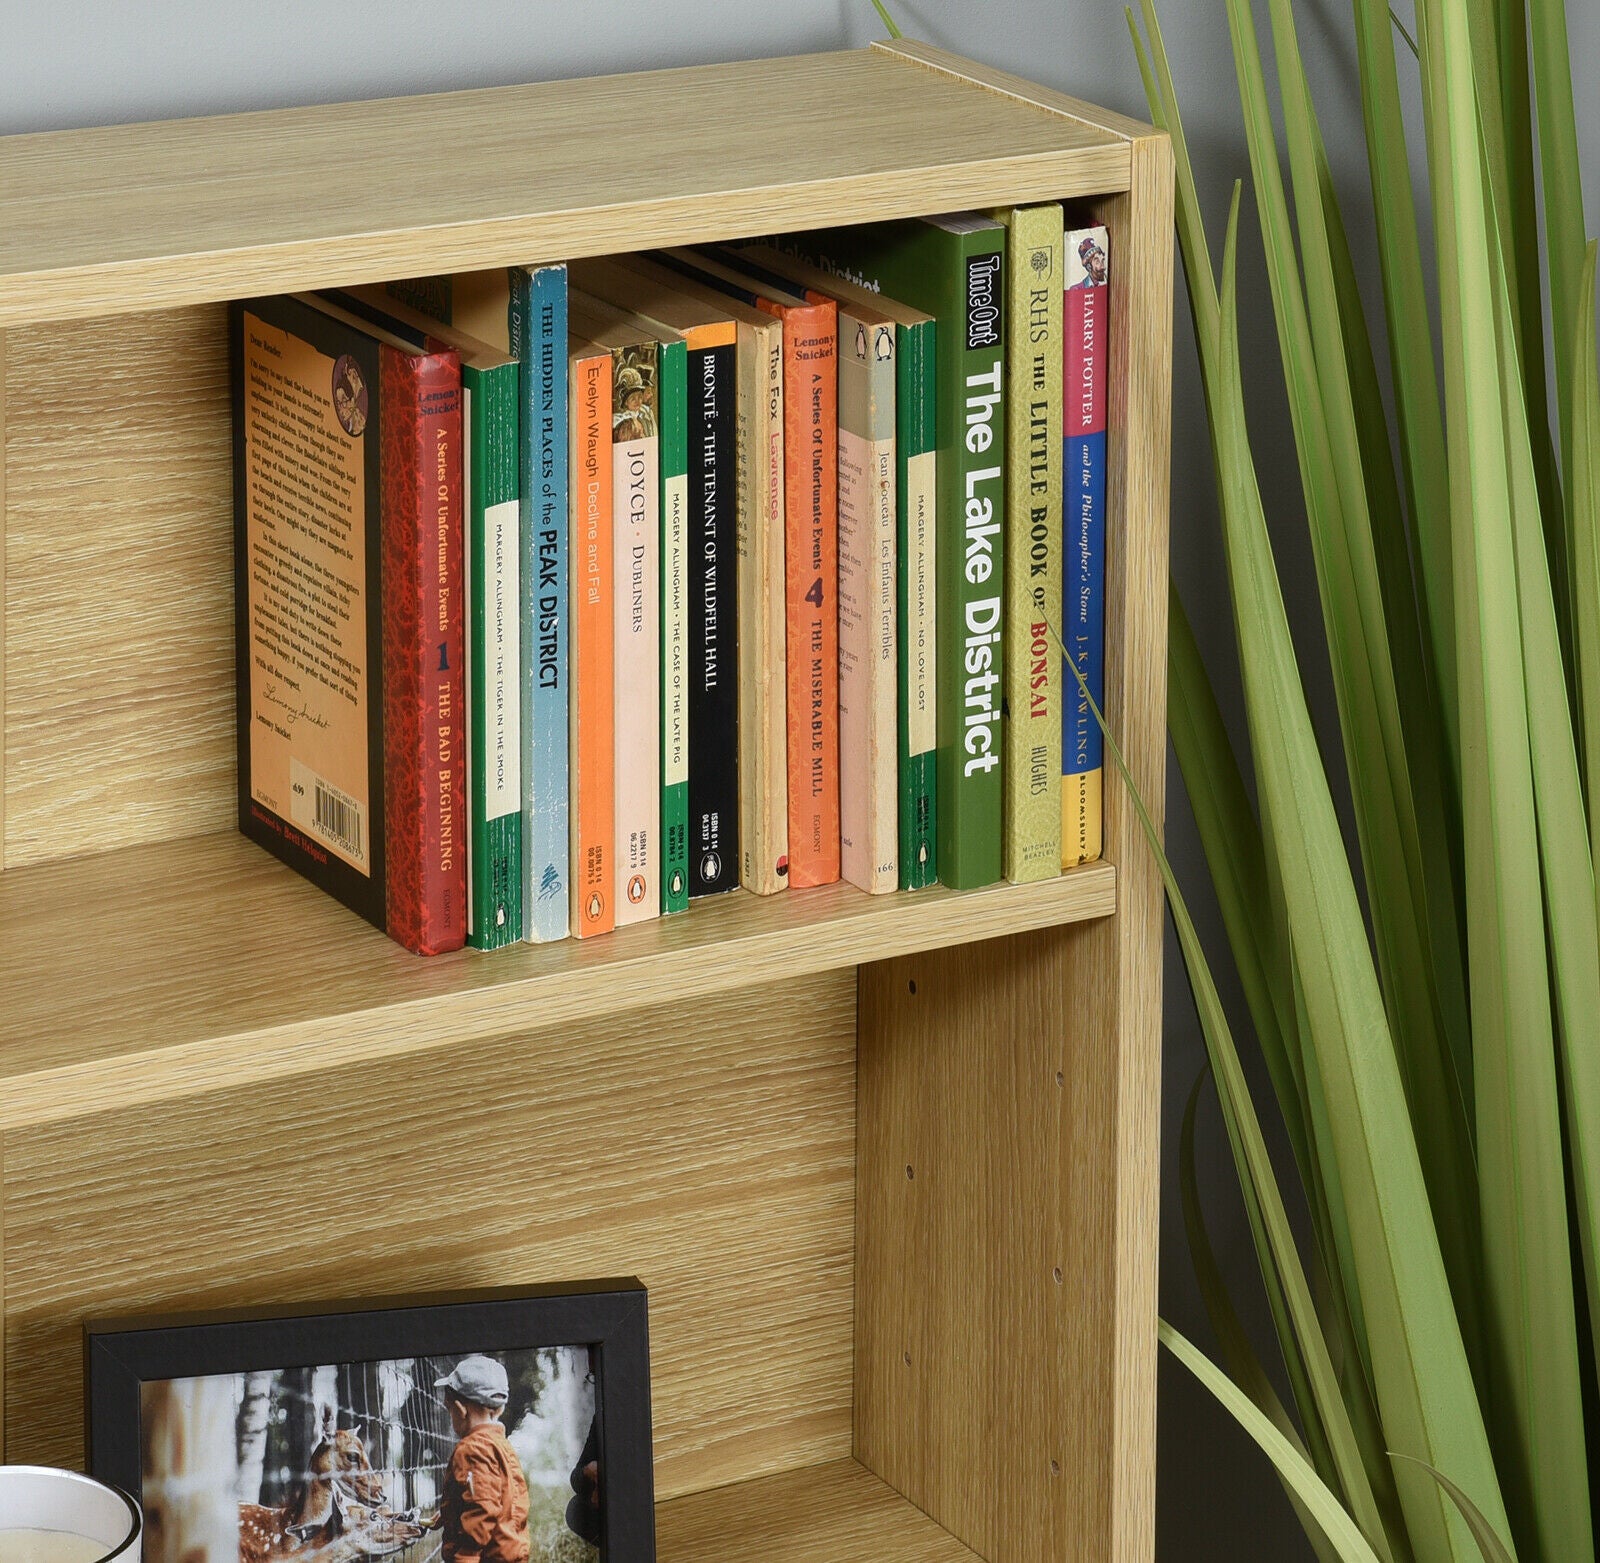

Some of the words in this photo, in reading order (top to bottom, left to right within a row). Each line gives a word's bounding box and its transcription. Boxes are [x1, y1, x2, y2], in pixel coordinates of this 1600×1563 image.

[542, 302, 553, 338] THE
[1030, 288, 1048, 343] RHS
[1082, 292, 1094, 352] HARRY
[512, 312, 521, 359] Distric
[794, 335, 835, 348] Lemony
[796, 349, 834, 360] Snicket
[542, 344, 553, 410] HIDDEN
[770, 345, 780, 380] The
[811, 374, 822, 383] A
[1033, 353, 1045, 391] THE
[418, 390, 458, 402] Lemony
[585, 367, 599, 419] Evelyn
[704, 355, 718, 420] BRONTË
[770, 387, 780, 420] Fox
[812, 387, 822, 425] Series
[1082, 357, 1093, 426] POTTER
[420, 402, 458, 415] Snicket
[965, 362, 1001, 453] The
[437, 428, 447, 439] A
[542, 417, 553, 479] PLACES
[585, 422, 599, 477] Waugh
[704, 432, 716, 467] THE
[812, 429, 823, 446] Of
[1030, 401, 1048, 496] LITTLE
[437, 443, 448, 481] Series
[879, 452, 889, 477] Jean
[1082, 445, 1092, 467] and
[437, 485, 448, 502] Of
[542, 483, 557, 498] of
[627, 450, 645, 524] JOYCE
[770, 432, 780, 520] Lawrence
[812, 449, 823, 524] Unfortunate
[1082, 469, 1092, 487] the
[542, 503, 556, 525] the
[588, 482, 600, 540] Decline
[672, 493, 680, 543] MARGERY
[704, 469, 716, 538] TENANT
[965, 466, 1001, 584] Lake
[1030, 505, 1048, 578] BOOK
[1079, 494, 1092, 582] Philosopher's
[437, 506, 449, 584] Unfortunate
[540, 530, 557, 590] PEAK
[588, 544, 600, 572] and
[705, 542, 716, 564] OF
[813, 528, 822, 570] Events
[882, 540, 891, 558] Les
[588, 578, 600, 604] Fall
[632, 544, 645, 633] DUBLINERS
[882, 561, 892, 604] Enfants
[1033, 587, 1045, 610] OF
[438, 589, 450, 632] Events
[705, 566, 716, 645] WILDFELL
[1080, 587, 1091, 623] Stone
[539, 596, 557, 689] DISTRICT
[673, 622, 681, 642] THE
[811, 620, 822, 652] THE
[882, 607, 892, 660] Terribles
[918, 630, 925, 647] NO
[673, 645, 681, 672] CASE
[705, 648, 716, 691] HALL
[1030, 622, 1048, 720] BONSAI
[438, 681, 450, 720] THE
[673, 675, 681, 690] OF
[964, 597, 1001, 777] District
[497, 714, 504, 726] IN
[673, 694, 681, 714] THE
[811, 659, 822, 751] MISERABLE
[438, 726, 450, 762] BAD
[673, 718, 681, 743] LATE
[673, 746, 681, 764] PIG
[1030, 746, 1047, 796] HUGHES
[812, 758, 822, 797] MILL
[438, 770, 451, 872] BEGINNING
[711, 812, 719, 832] ISBN
[640, 858, 647, 867] 14
[711, 840, 719, 849] 14
[595, 874, 602, 883] 14
[442, 888, 451, 929] EGMONT
